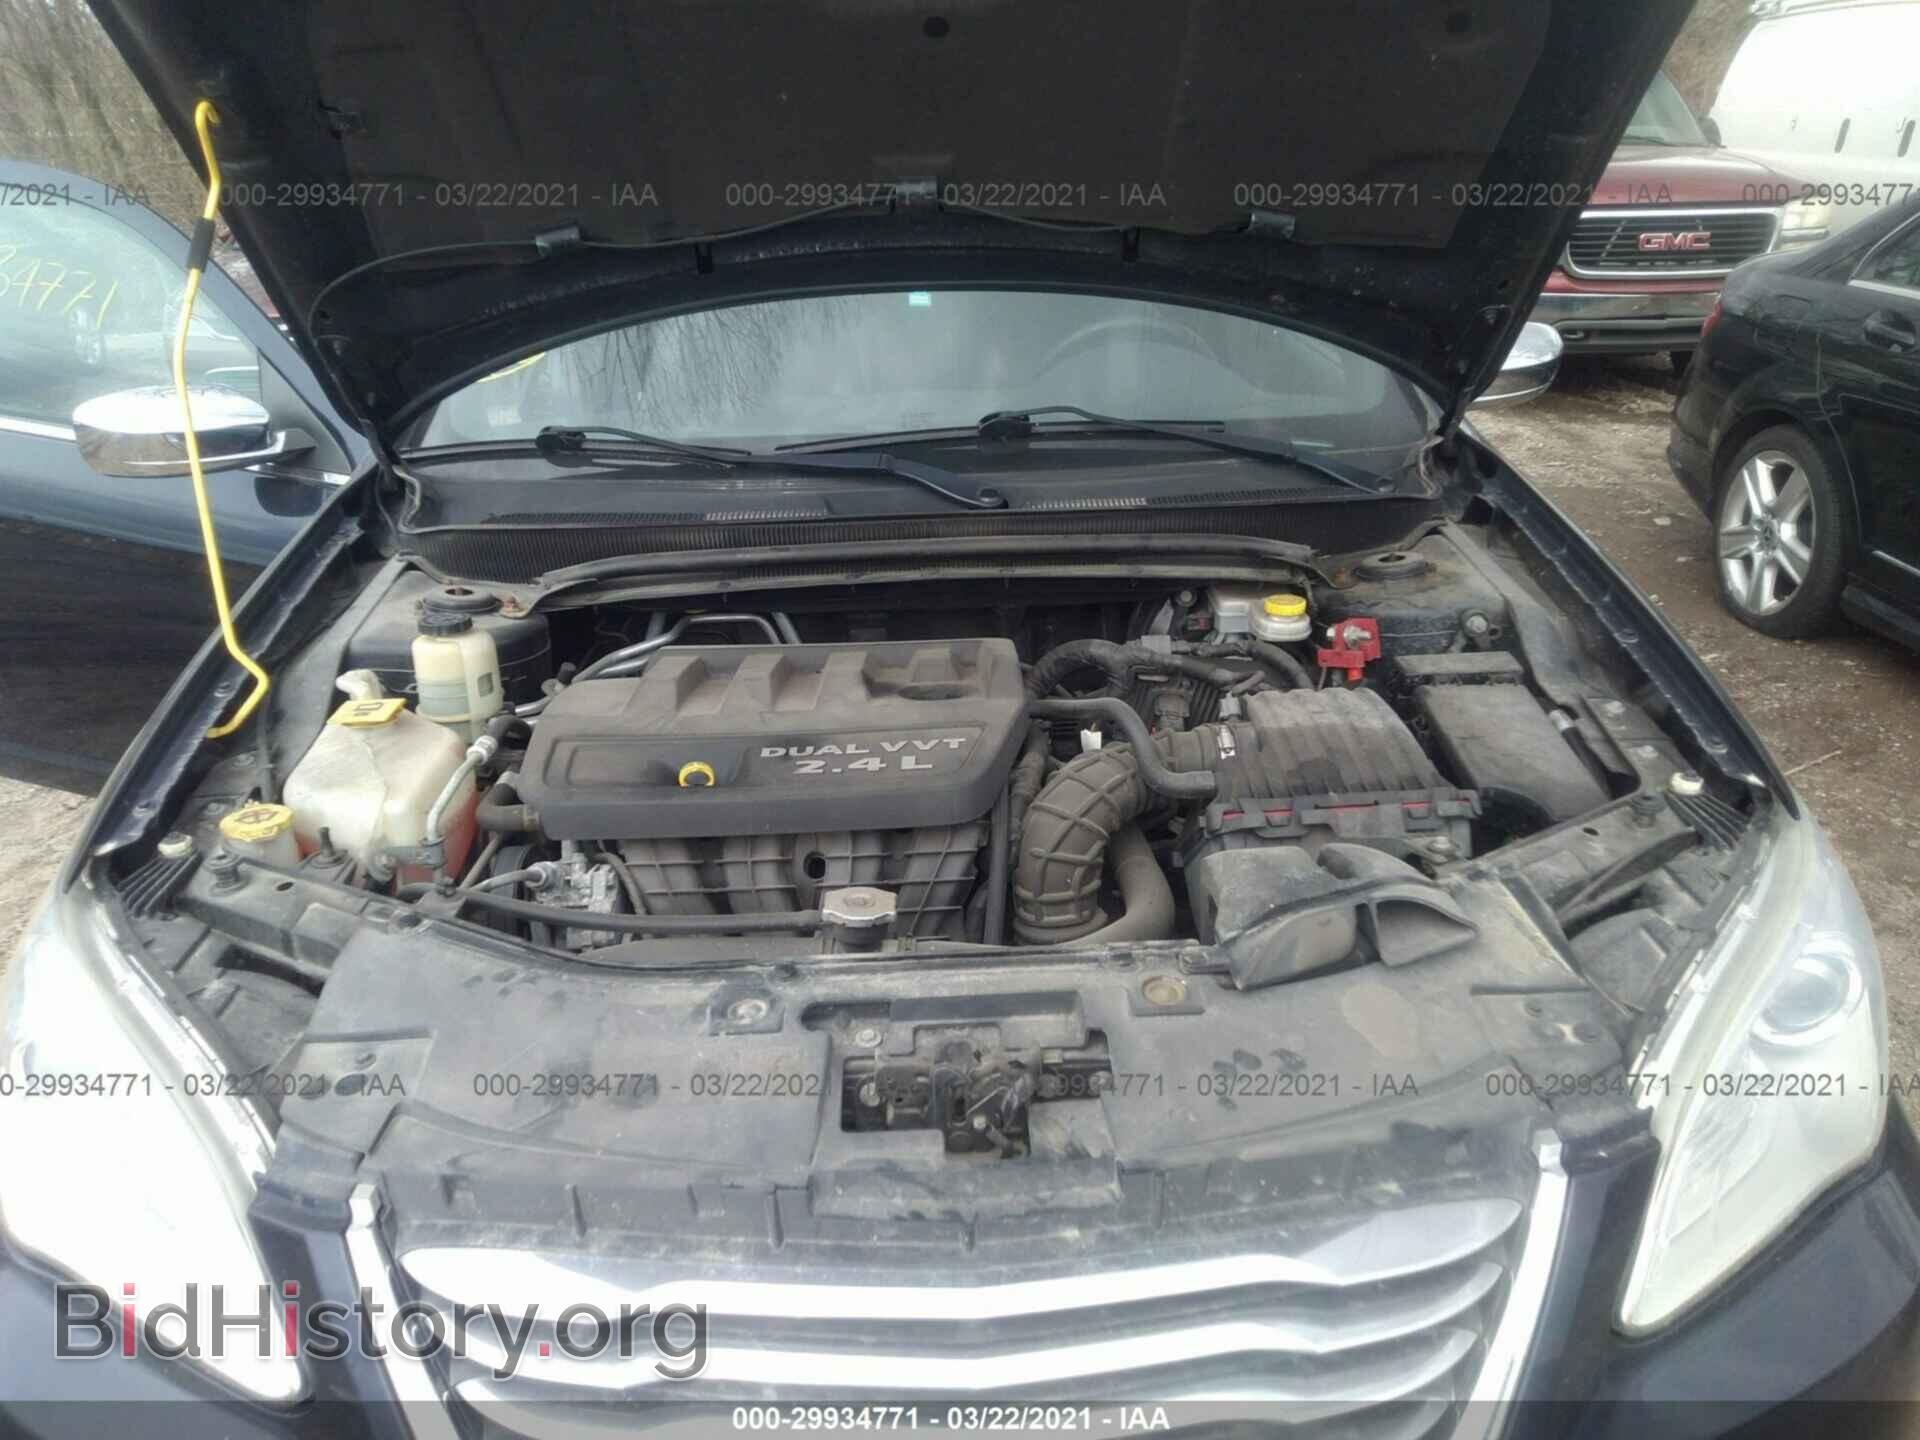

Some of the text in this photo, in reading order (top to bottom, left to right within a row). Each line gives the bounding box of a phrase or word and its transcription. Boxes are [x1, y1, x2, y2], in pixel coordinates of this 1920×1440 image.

[1638, 231, 1712, 251] GMC
[760, 738, 967, 757] DUAL VVT
